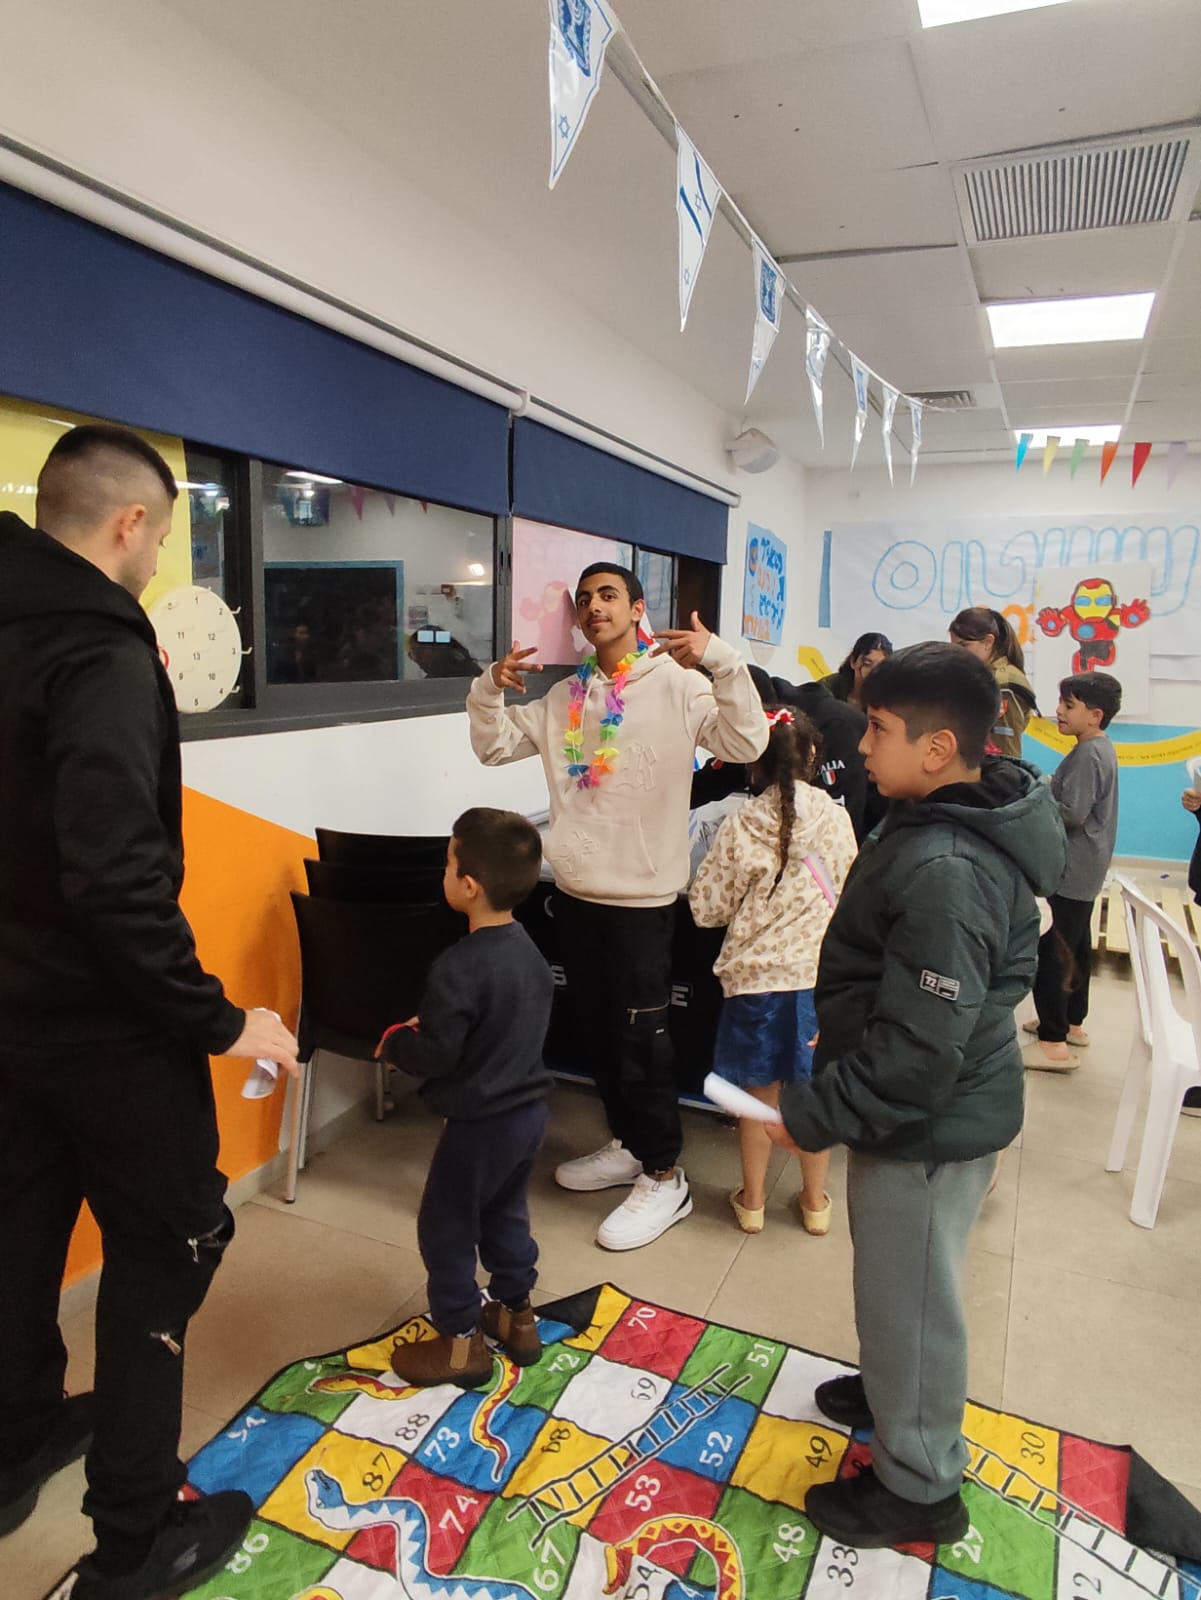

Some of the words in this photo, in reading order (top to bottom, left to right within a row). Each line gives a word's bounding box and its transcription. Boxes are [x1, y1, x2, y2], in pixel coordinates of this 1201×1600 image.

[177, 631, 185, 639] 11
[208, 633, 216, 641] 12
[193, 653, 201, 661] 13
[816, 759, 846, 776] ALIA
[627, 1307, 657, 1331] 70
[547, 1353, 581, 1373] 72
[747, 1343, 777, 1368] 51
[395, 1413, 430, 1441] 88
[423, 1426, 460, 1463] 73
[699, 1431, 734, 1468] 52
[804, 1435, 833, 1468] 49
[1020, 1431, 1046, 1465] 30
[362, 1451, 393, 1492] 87
[624, 1474, 661, 1512] 53
[438, 1494, 479, 1534] 74
[225, 1533, 270, 1574] 86
[773, 1523, 806, 1563] 48
[533, 1537, 567, 1591] 67
[827, 1545, 859, 1588] 33
[1072, 1571, 1103, 1600] 2
